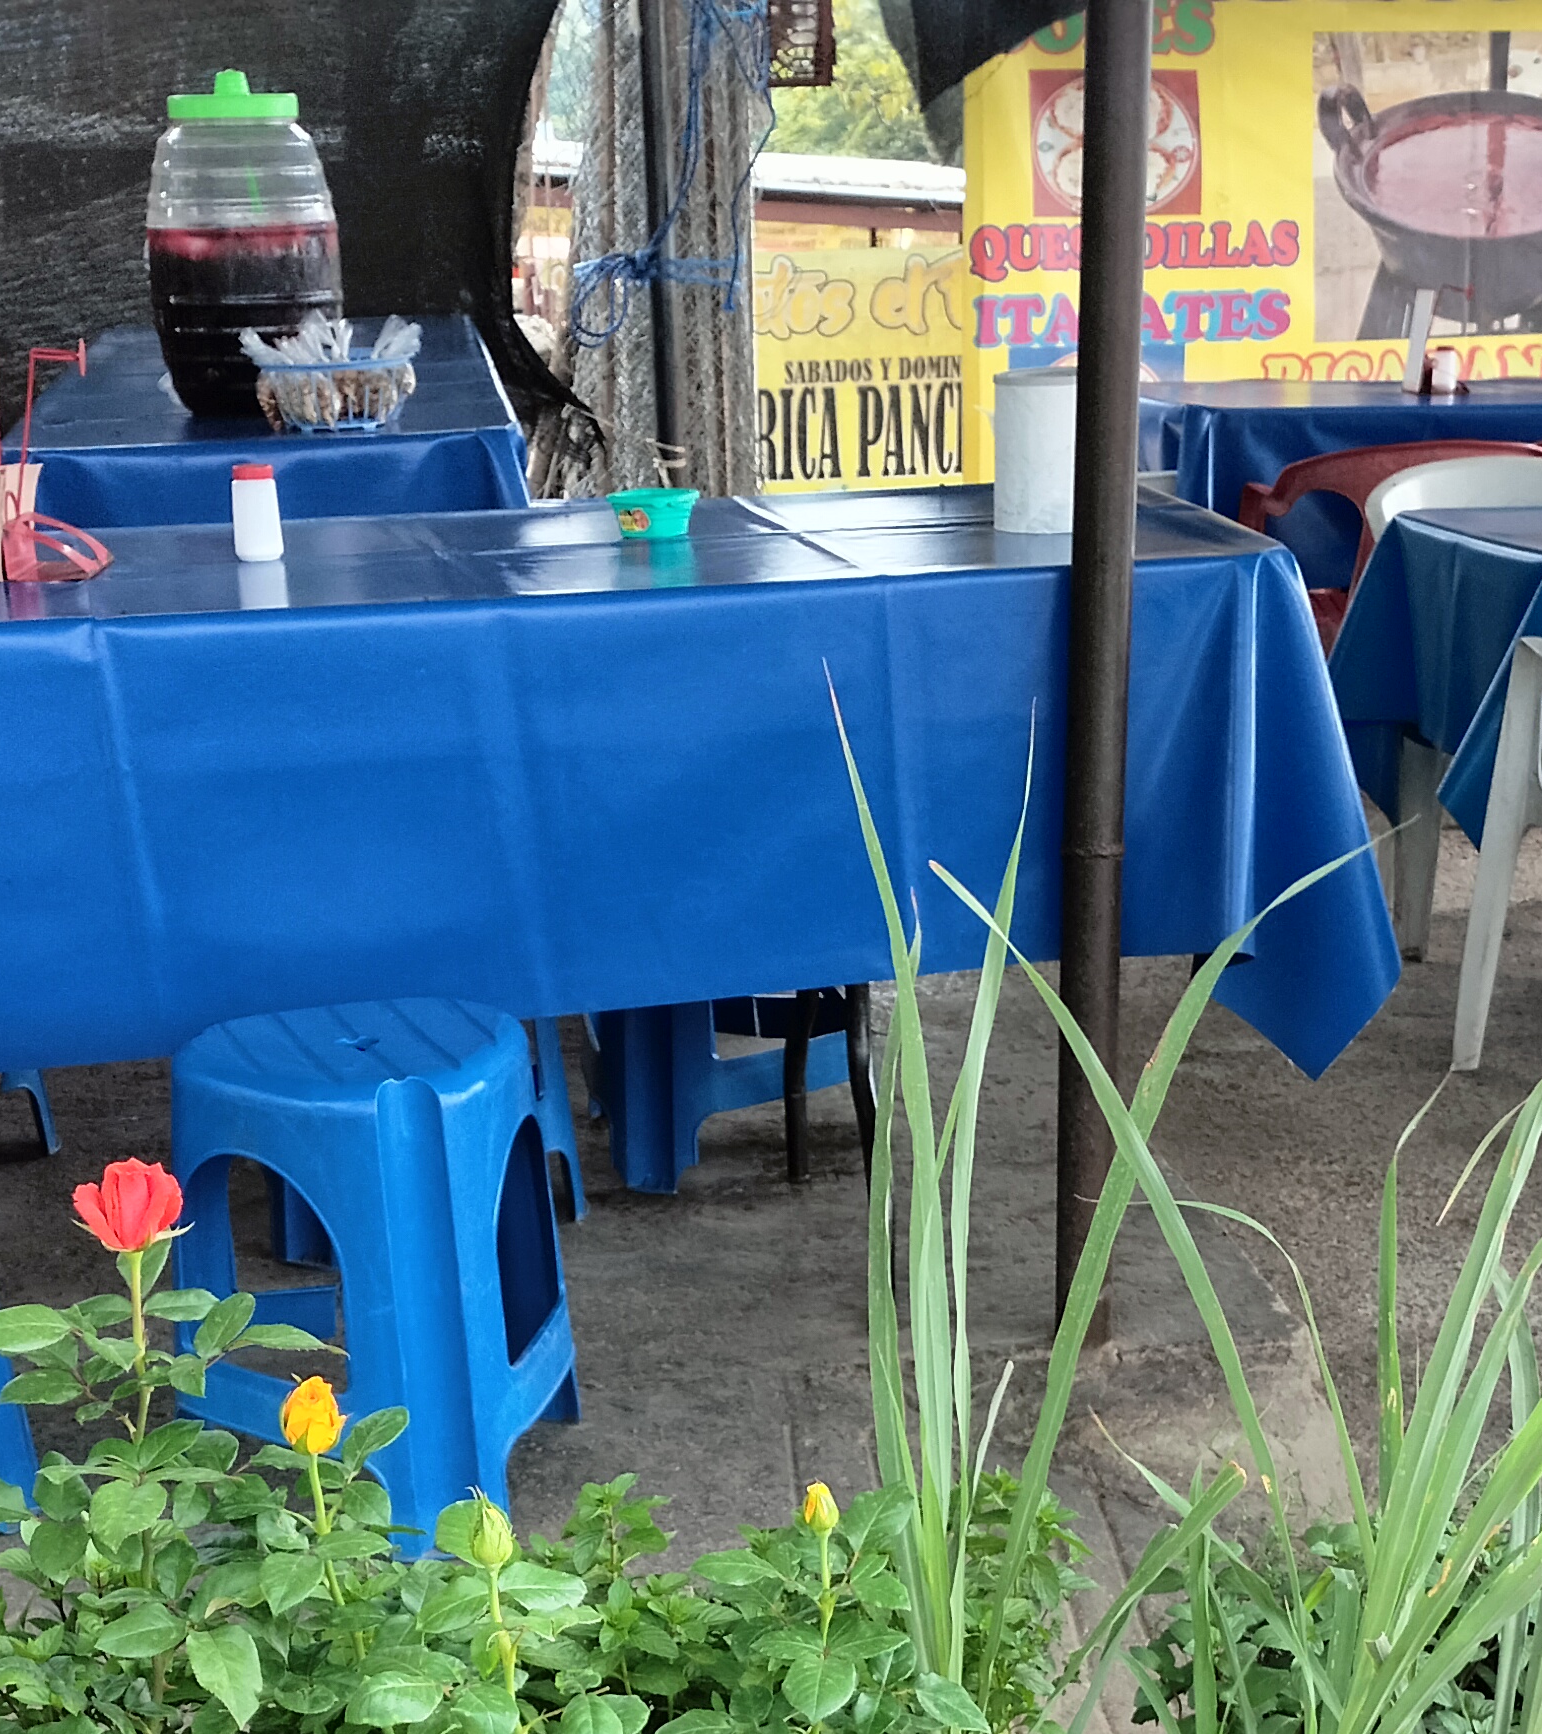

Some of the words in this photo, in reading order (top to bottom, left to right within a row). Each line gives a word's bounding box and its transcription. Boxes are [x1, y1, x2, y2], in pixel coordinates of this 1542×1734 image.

[969, 219, 1300, 283] QUEDILLAS
[973, 289, 1291, 348] ITAATES
[784, 357, 874, 385] SABADOS
[879, 357, 893, 381] Y
[757, 385, 842, 481] RICA
